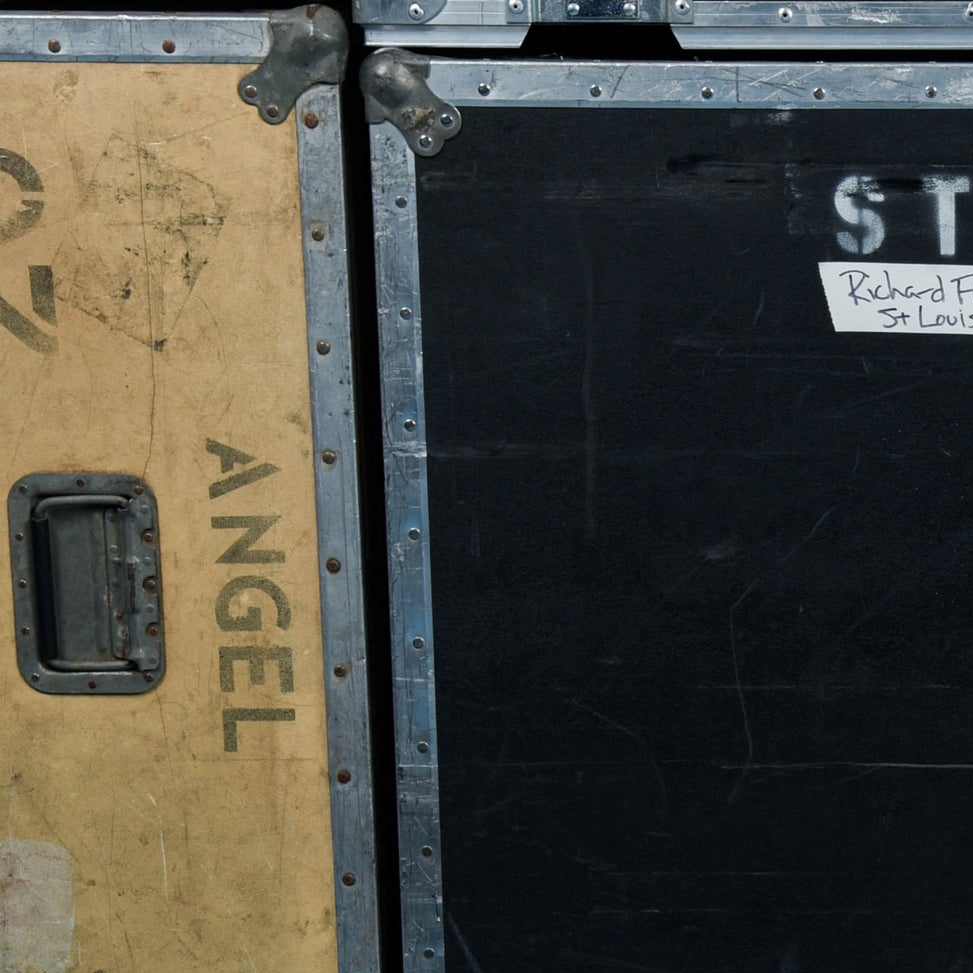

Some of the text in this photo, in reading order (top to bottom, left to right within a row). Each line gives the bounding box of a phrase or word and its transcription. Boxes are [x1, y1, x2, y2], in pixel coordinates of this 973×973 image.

[839, 269, 945, 306] Richard
[877, 307, 910, 330] St
[205, 437, 296, 752] ANGEL
